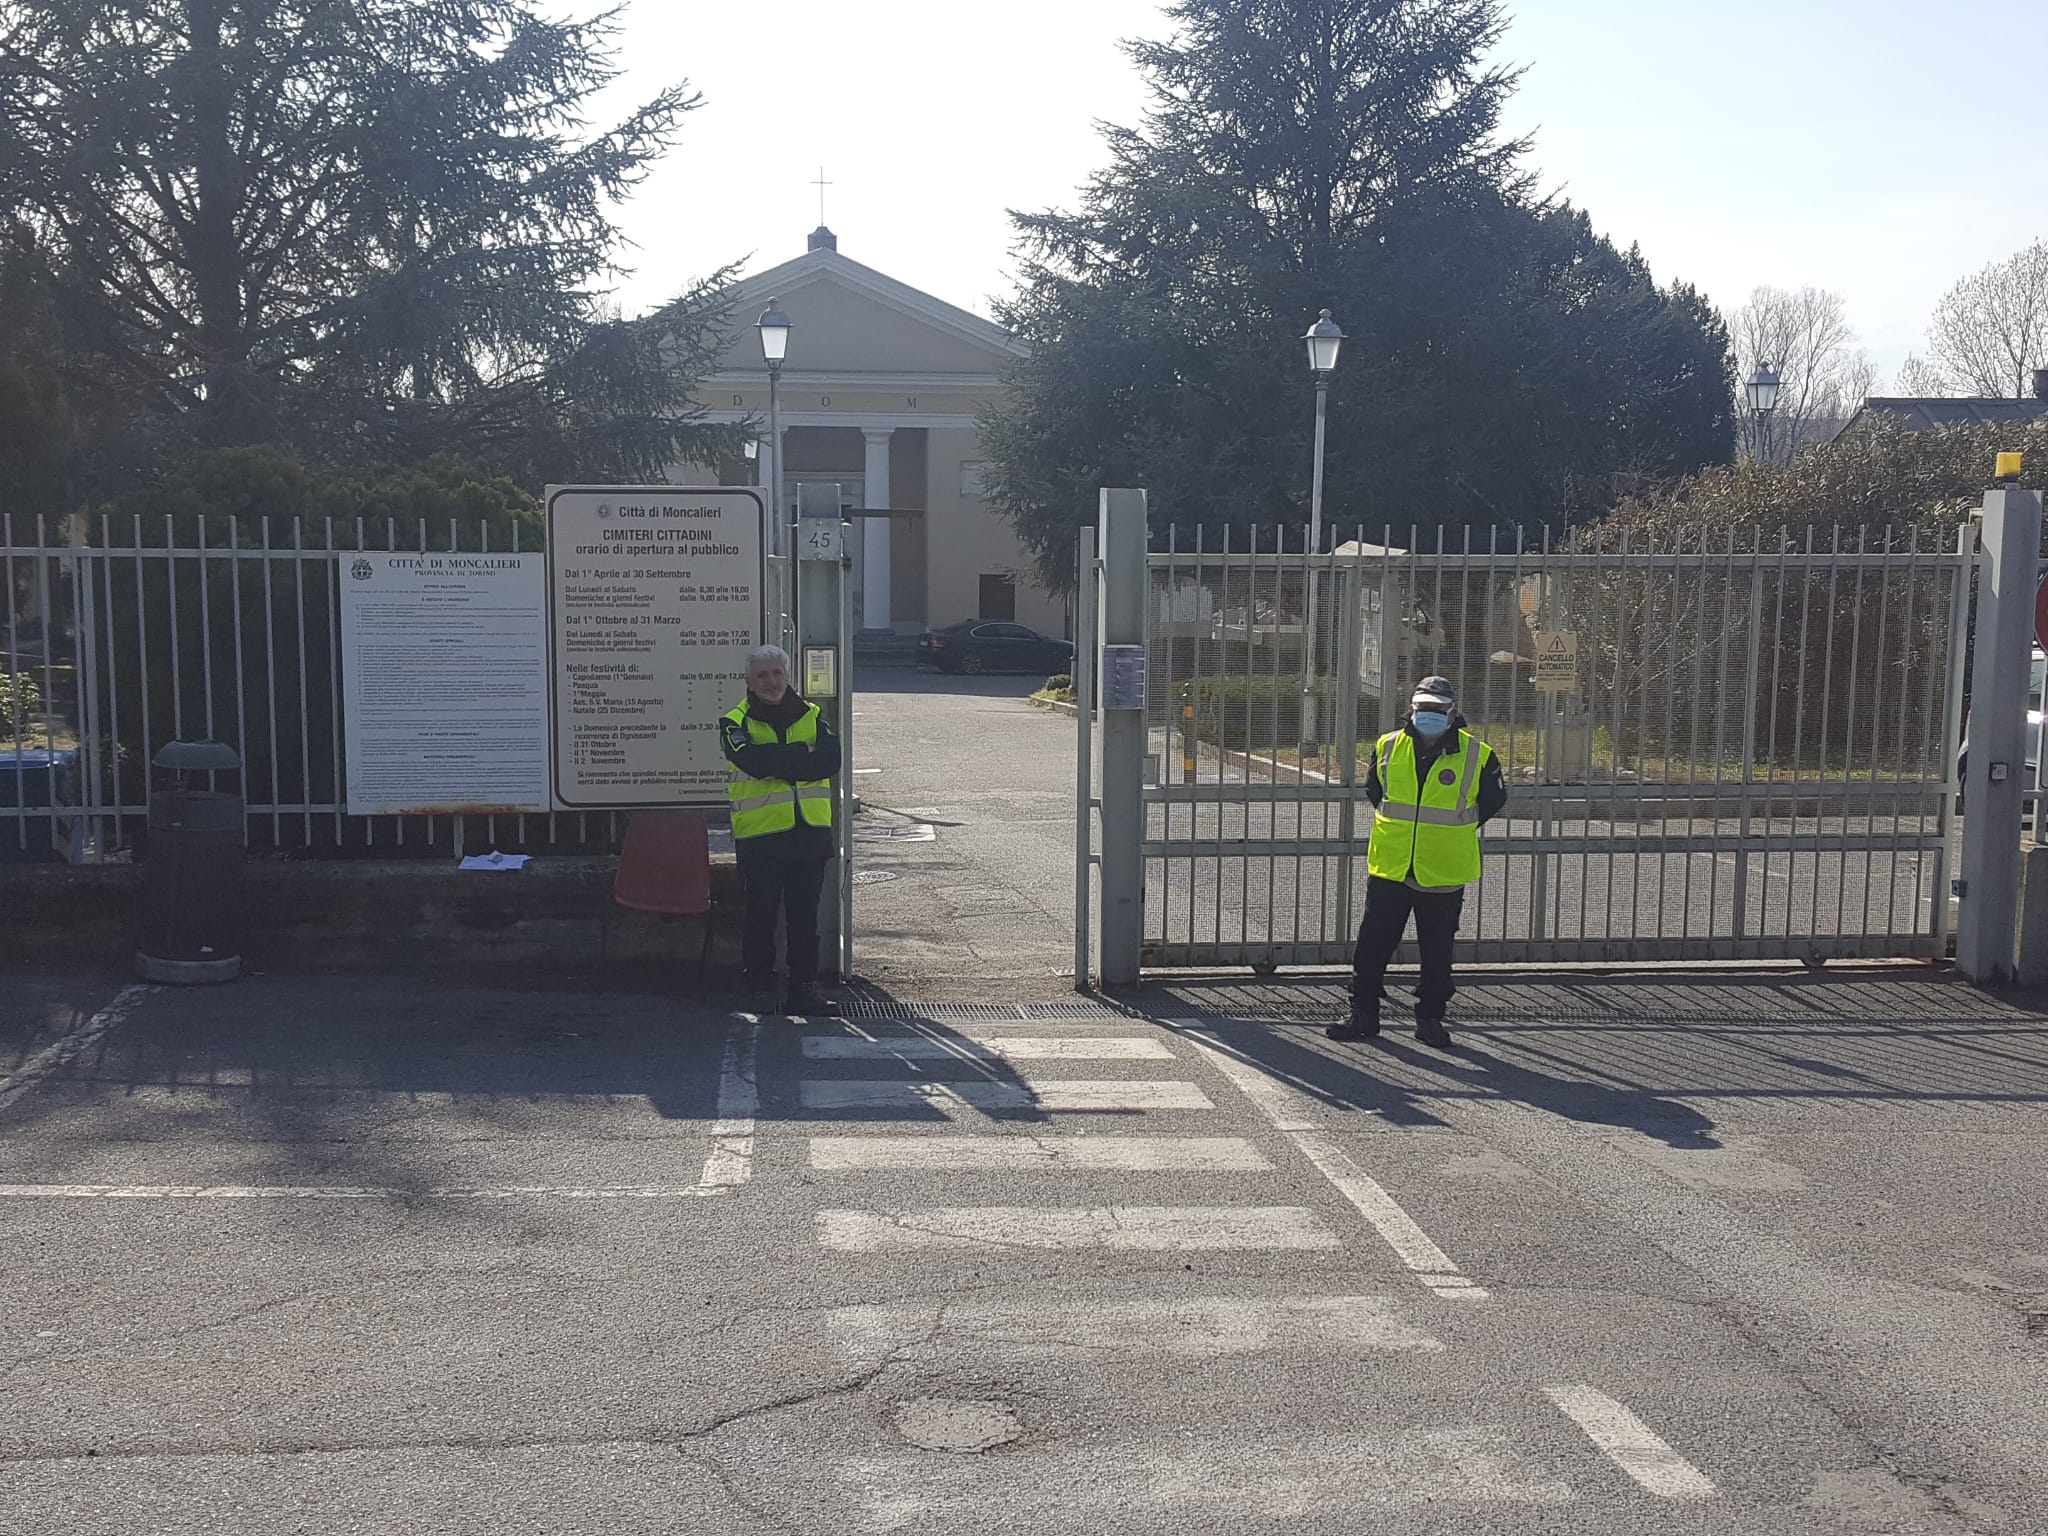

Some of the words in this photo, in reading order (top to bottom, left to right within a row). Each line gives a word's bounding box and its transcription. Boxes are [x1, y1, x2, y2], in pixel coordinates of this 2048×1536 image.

[619, 506, 646, 518] Città
[649, 506, 659, 518] di
[663, 506, 722, 518] Moncalieri
[603, 529, 653, 541] CIMITERI
[657, 529, 712, 541] CITTADINI
[809, 532, 830, 548] 45
[576, 544, 610, 556] orario
[613, 544, 623, 556] di
[627, 544, 674, 558] apertura
[678, 544, 688, 556] al
[691, 544, 739, 558] pubblico
[389, 559, 424, 568] CITTA'
[431, 559, 442, 568] DI
[449, 559, 521, 568] MONCALIERI
[565, 569, 580, 578] Dal
[594, 569, 620, 580] Aprile
[622, 569, 630, 578] al
[633, 569, 644, 578] 30
[646, 569, 692, 578] Settembre
[566, 615, 581, 625] Dal
[595, 615, 628, 625] Ottobre
[630, 615, 638, 625] al
[640, 615, 650, 625] 31
[654, 615, 681, 625] Marzo
[1539, 654, 1574, 662] CANCELLO
[566, 664, 588, 673] Nelle
[591, 664, 626, 673] festività
[628, 664, 640, 673] di:
